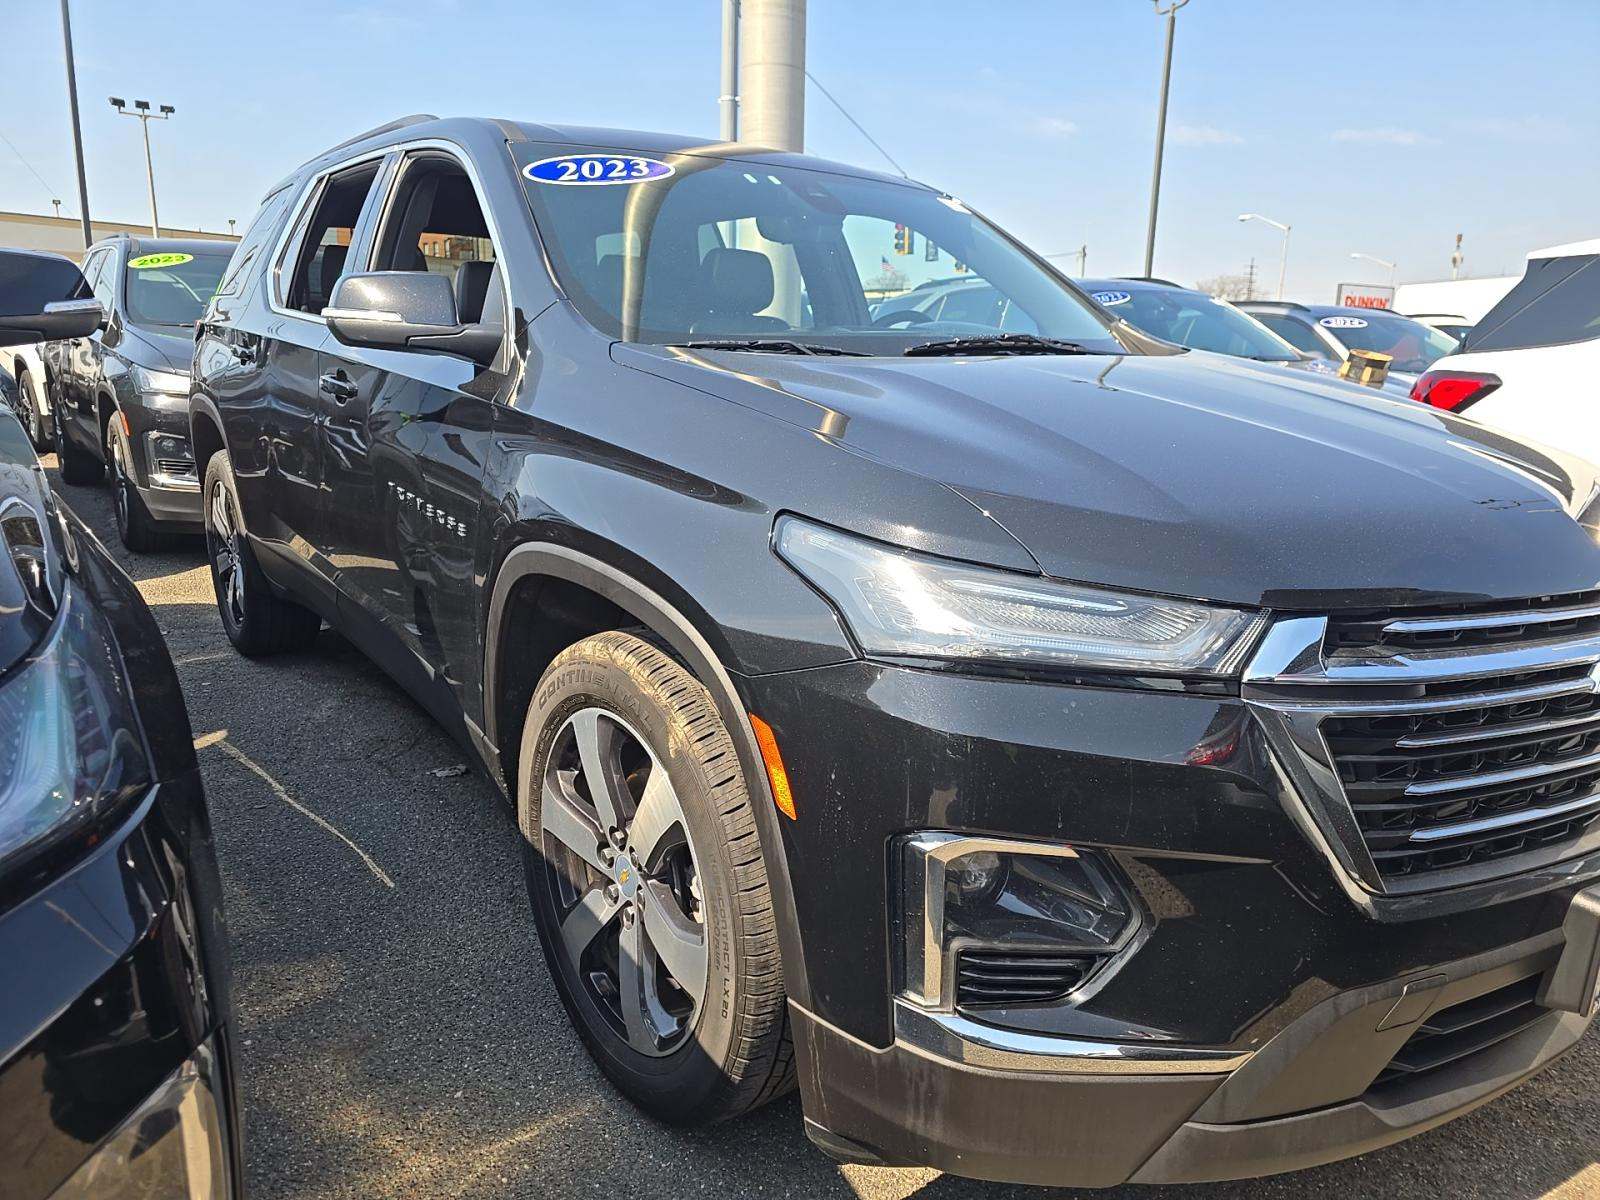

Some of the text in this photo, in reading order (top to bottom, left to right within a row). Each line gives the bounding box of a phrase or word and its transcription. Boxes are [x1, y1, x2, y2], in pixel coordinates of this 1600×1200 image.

[557, 159, 650, 181] 2023
[138, 255, 186, 266] 2023
[721, 1000, 730, 1020] 20
